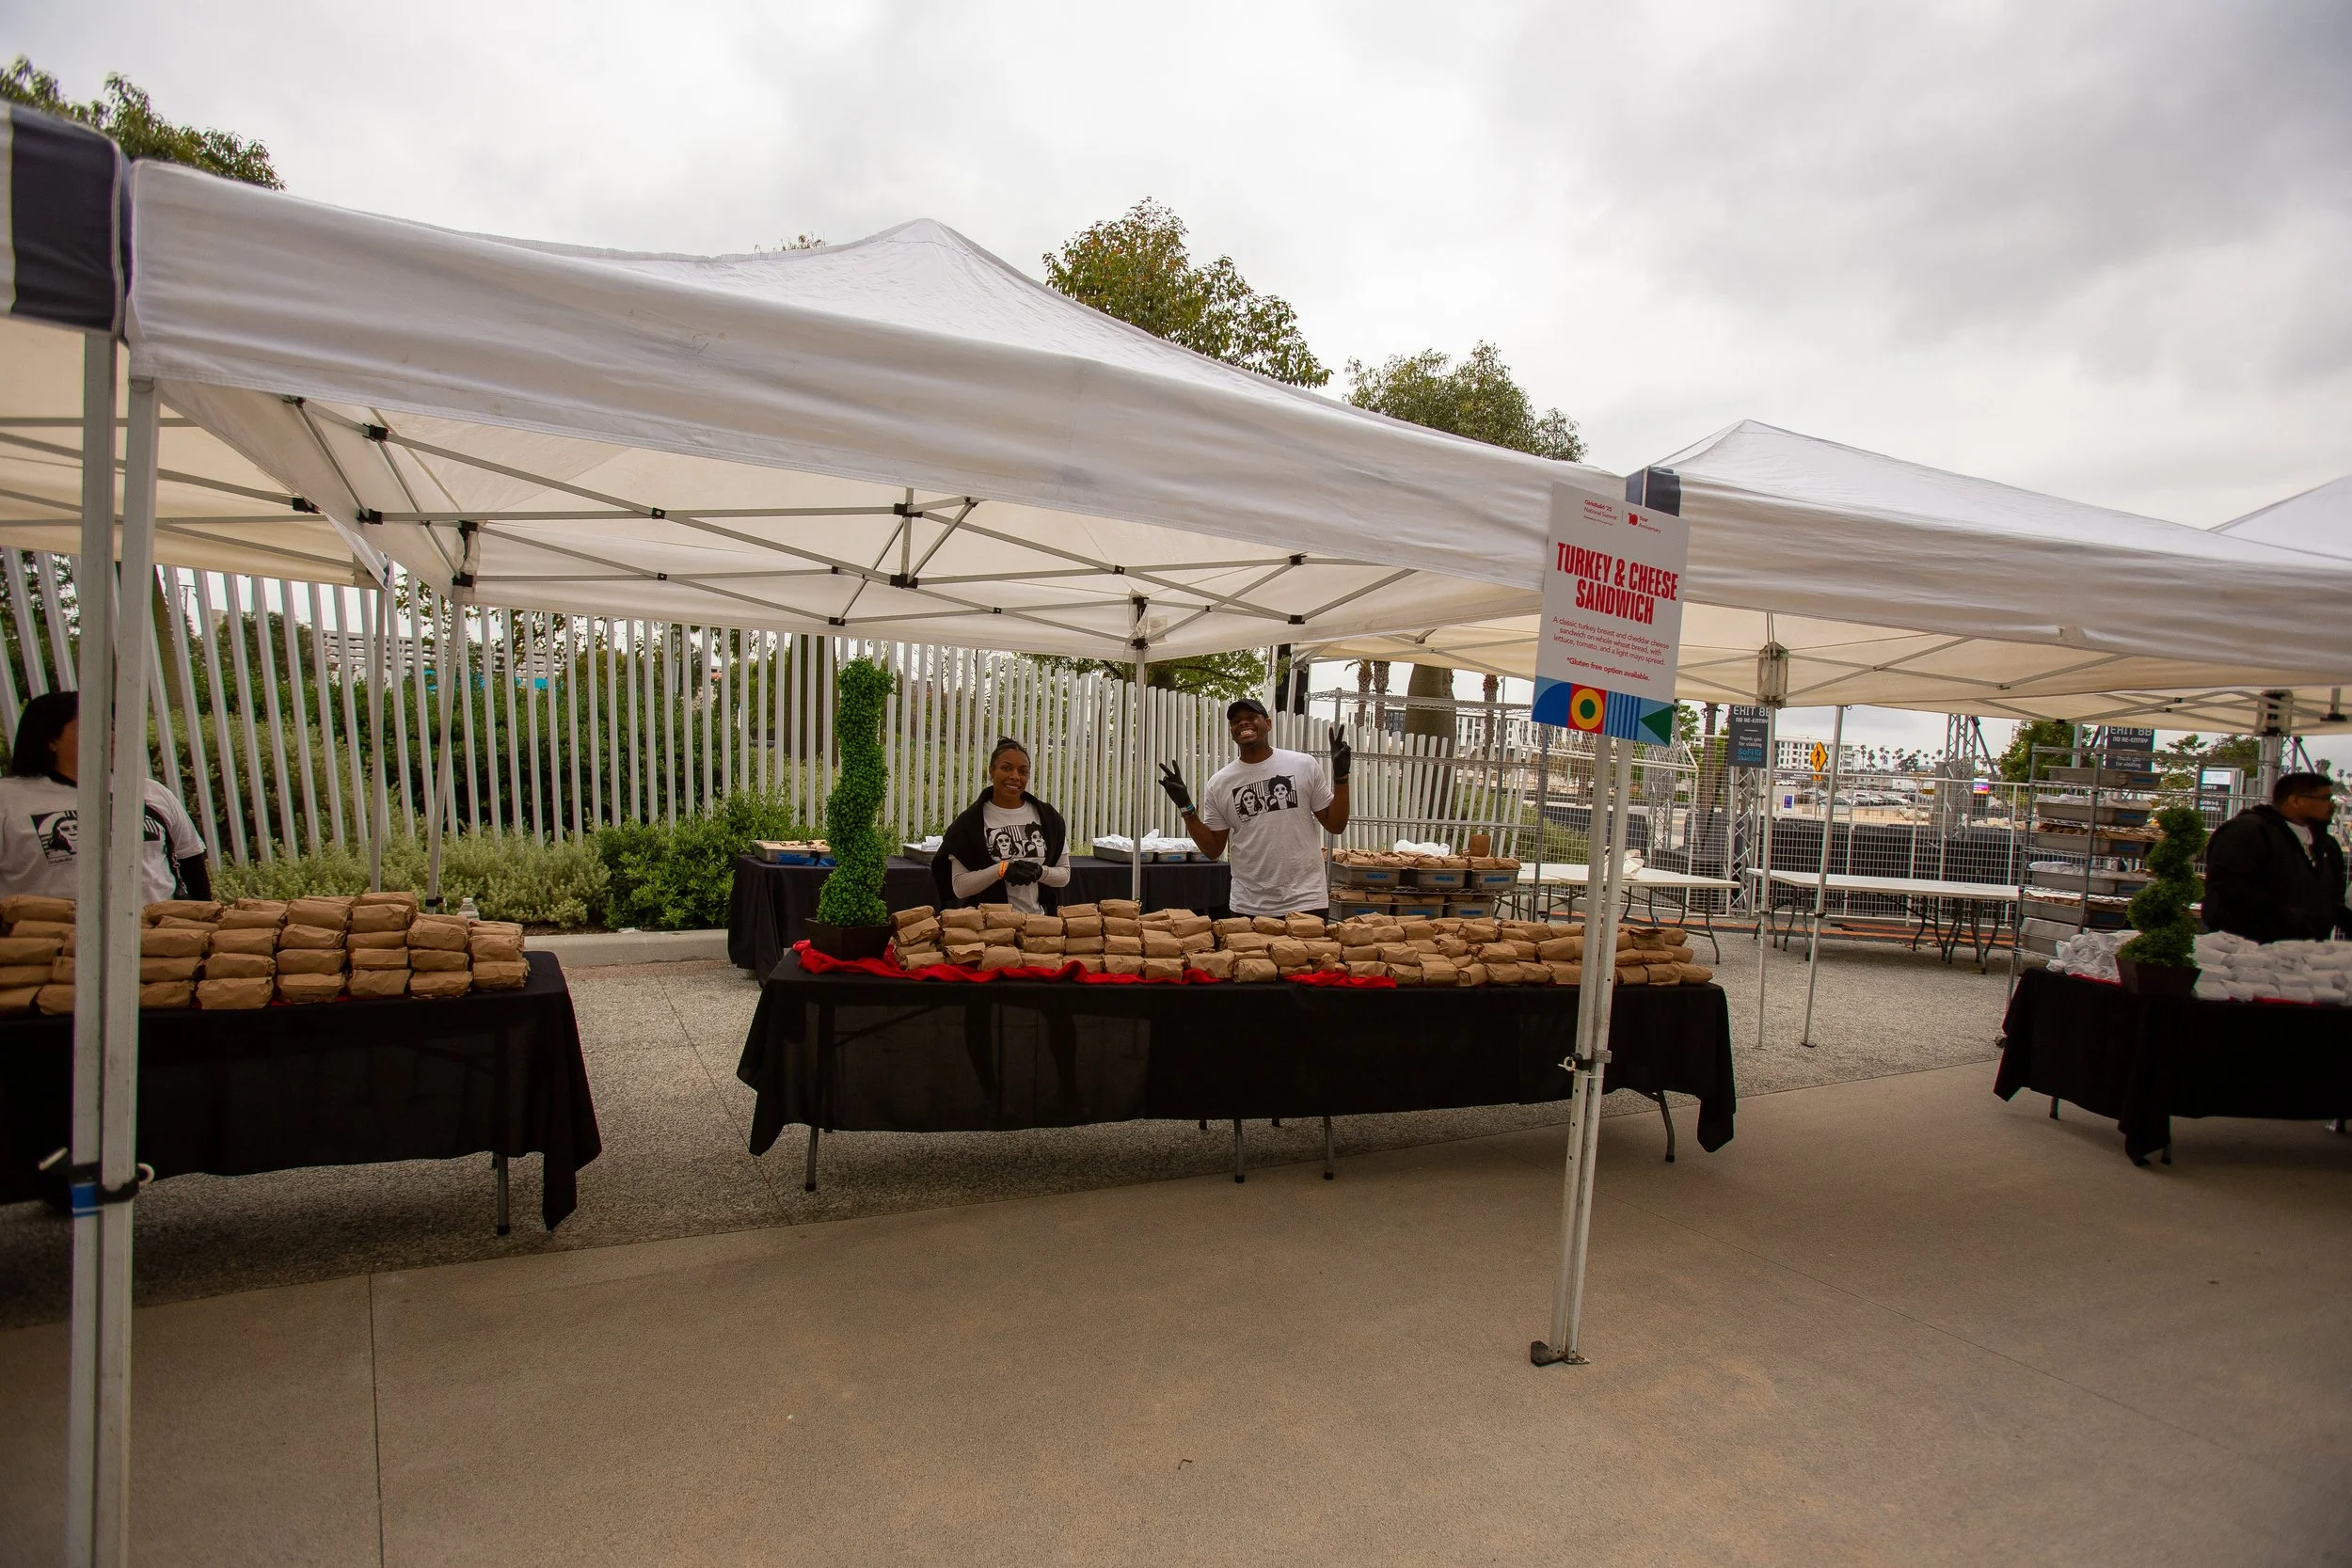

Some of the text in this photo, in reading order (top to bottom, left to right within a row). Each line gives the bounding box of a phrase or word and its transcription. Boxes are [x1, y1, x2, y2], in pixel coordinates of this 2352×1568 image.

[1583, 507, 1617, 520] National Summit
[1638, 523, 1661, 534] Anniversary
[1557, 542, 1678, 601] TURKEY & CHEESE
[1576, 578, 1654, 625] SANDWICH
[1559, 618, 1577, 628] classic
[1578, 623, 1596, 633] turkey
[1597, 628, 1615, 636] breast
[1627, 634, 1649, 645] cheddar
[1651, 639, 1669, 649] cheese
[1559, 628, 1585, 638] sandwich
[1595, 635, 1613, 645] whole
[1613, 640, 1630, 649] wheat
[1631, 643, 1648, 653] bread,
[1650, 648, 1662, 656] with
[1554, 634, 1575, 645] lettuce,
[1576, 640, 1597, 651] tomato,
[1600, 645, 1610, 653] and
[1616, 648, 1628, 658] light
[1629, 653, 1645, 661] mayo
[1645, 656, 1666, 666] spread.
[1591, 662, 1603, 670] free
[1604, 666, 1623, 676] option
[1623, 670, 1650, 681] available.
[1733, 706, 1756, 716] EXIT
